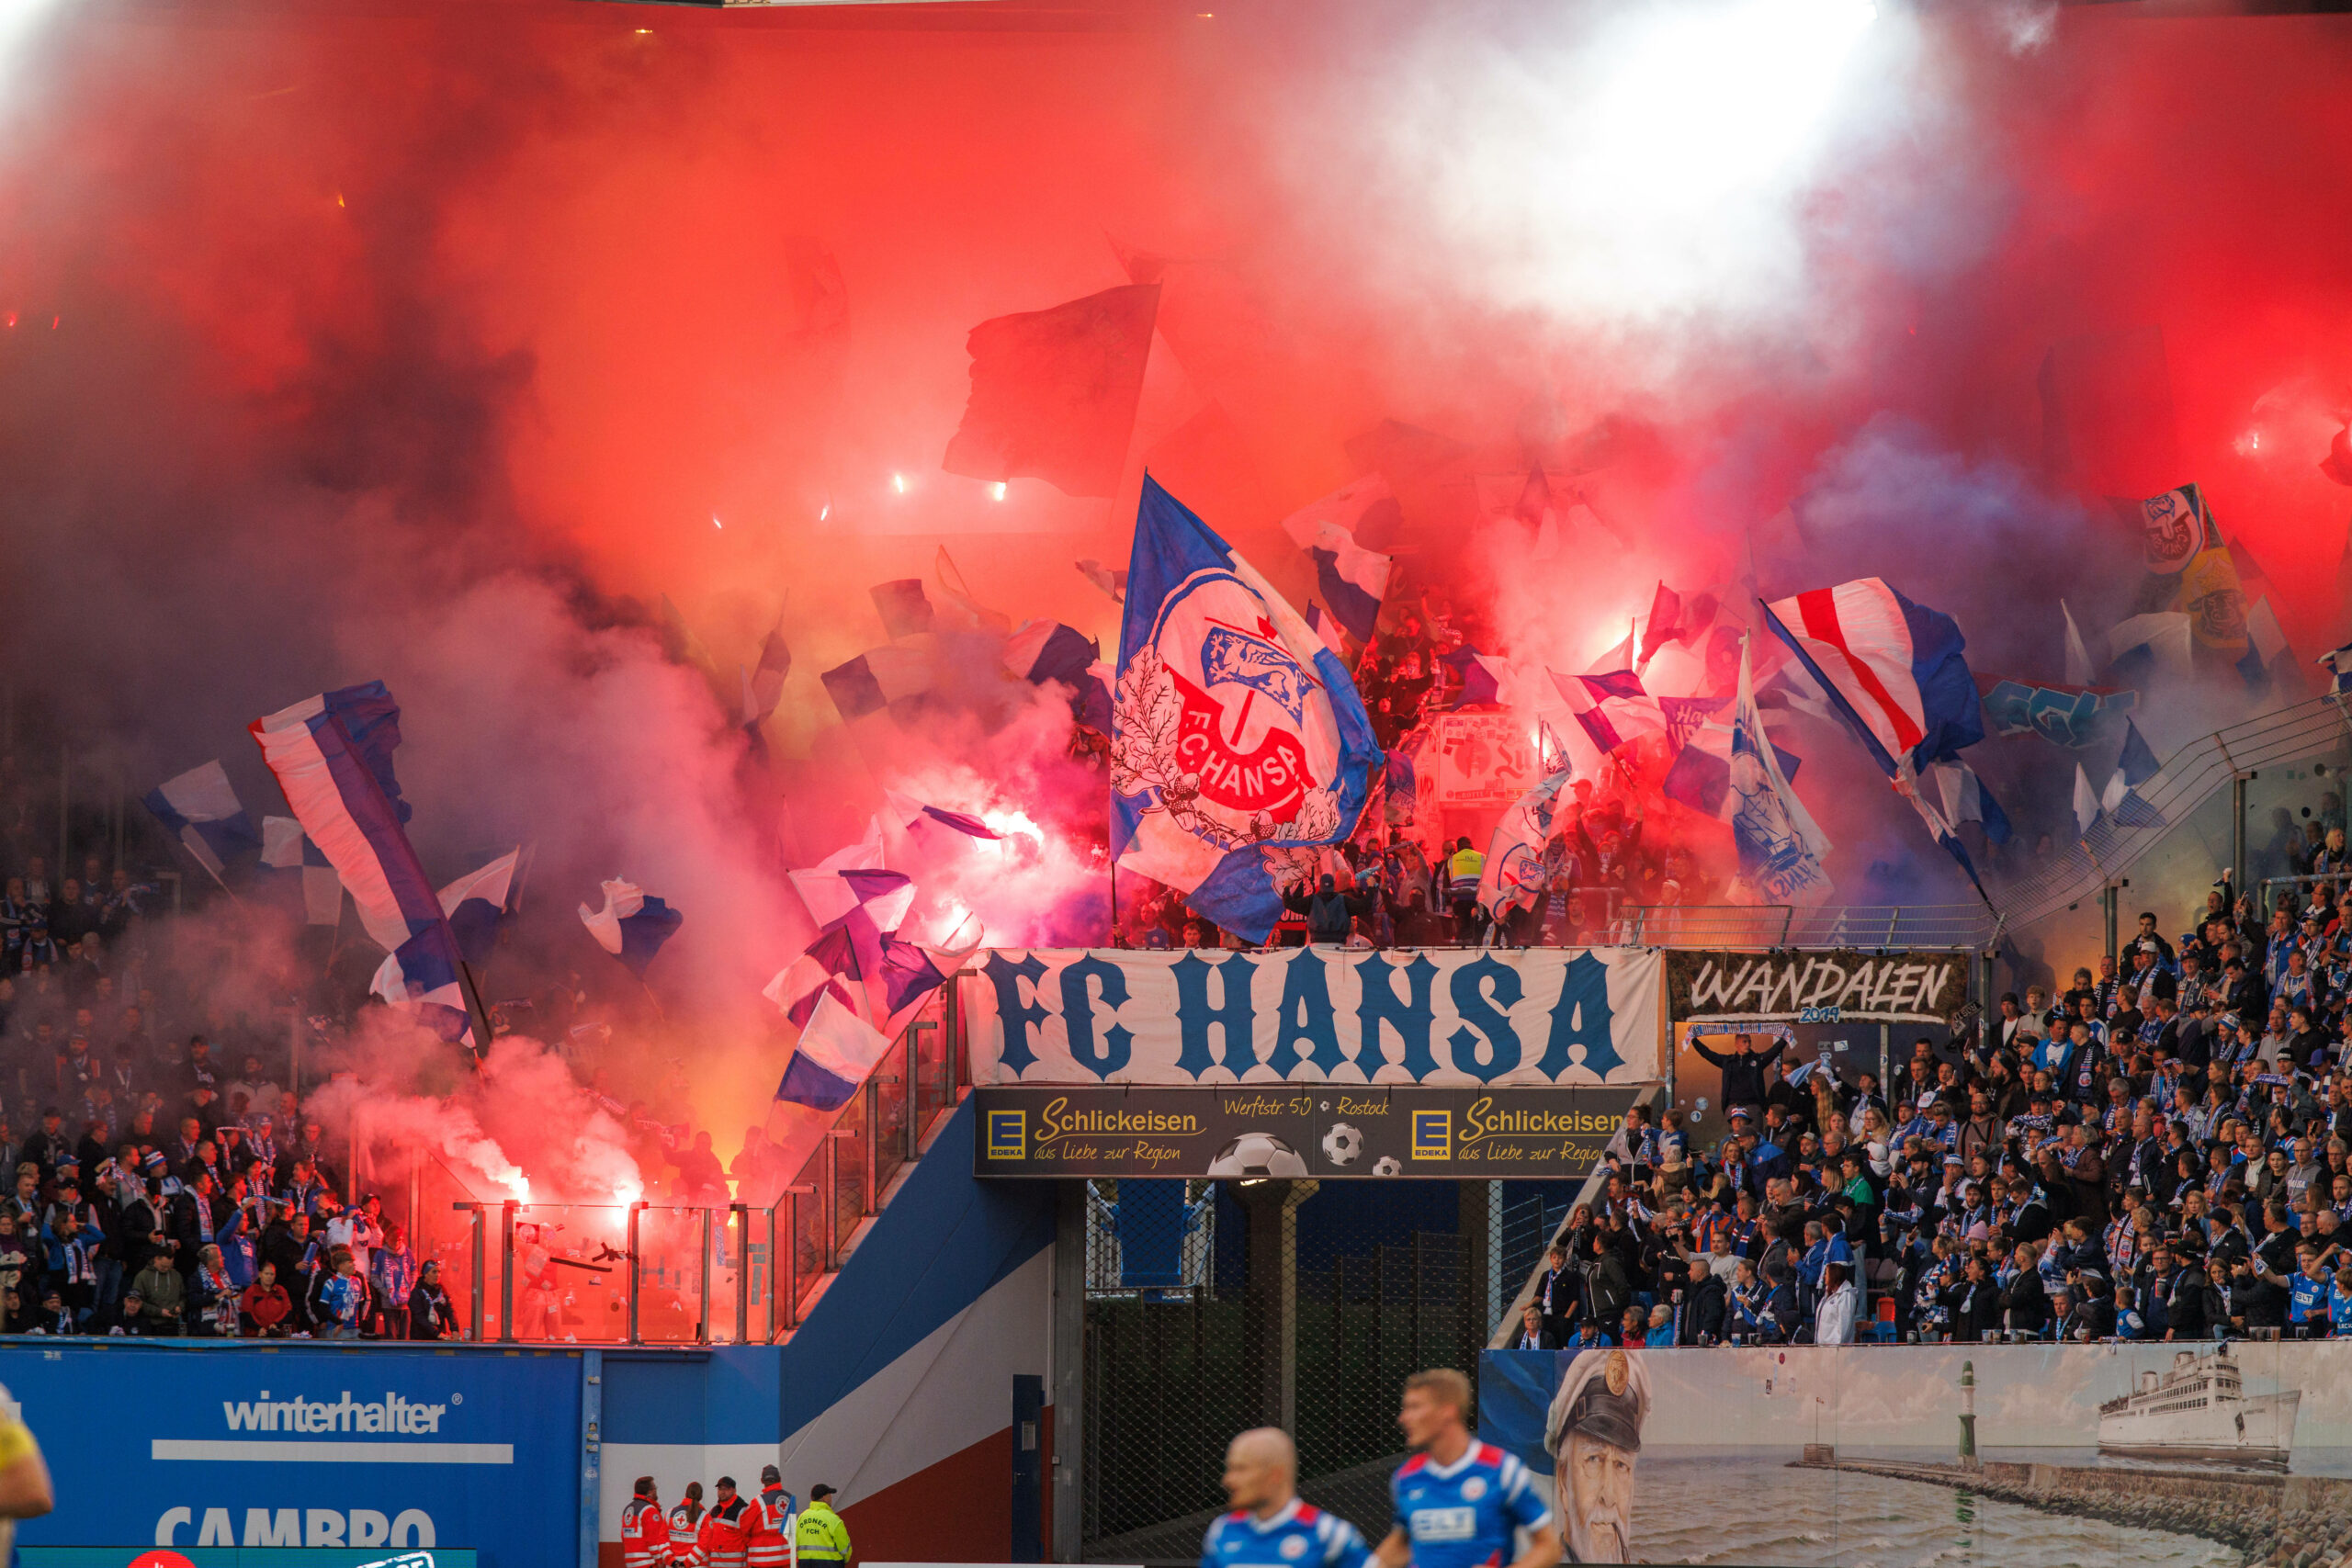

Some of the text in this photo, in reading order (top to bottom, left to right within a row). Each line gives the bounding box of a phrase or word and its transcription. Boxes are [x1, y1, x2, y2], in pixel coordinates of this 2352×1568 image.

[1691, 956, 1950, 1013] WANDALEN
[980, 946, 1626, 1084] FC HANSA
[1035, 1097, 1196, 1141] Schlickeisen
[1225, 1095, 1389, 1117] Werftstr. 50 Rostock
[1459, 1097, 1623, 1141] Schlickeisen
[1035, 1140, 1181, 1169] aus Liebe zur Region
[1458, 1148, 1480, 1160] aus
[1487, 1141, 1522, 1160] Liebe
[1529, 1147, 1555, 1160] zur
[2296, 1292, 2312, 1303] SLT
[223, 1391, 446, 1434] winterhalter
[799, 1517, 828, 1530] ORDNER
